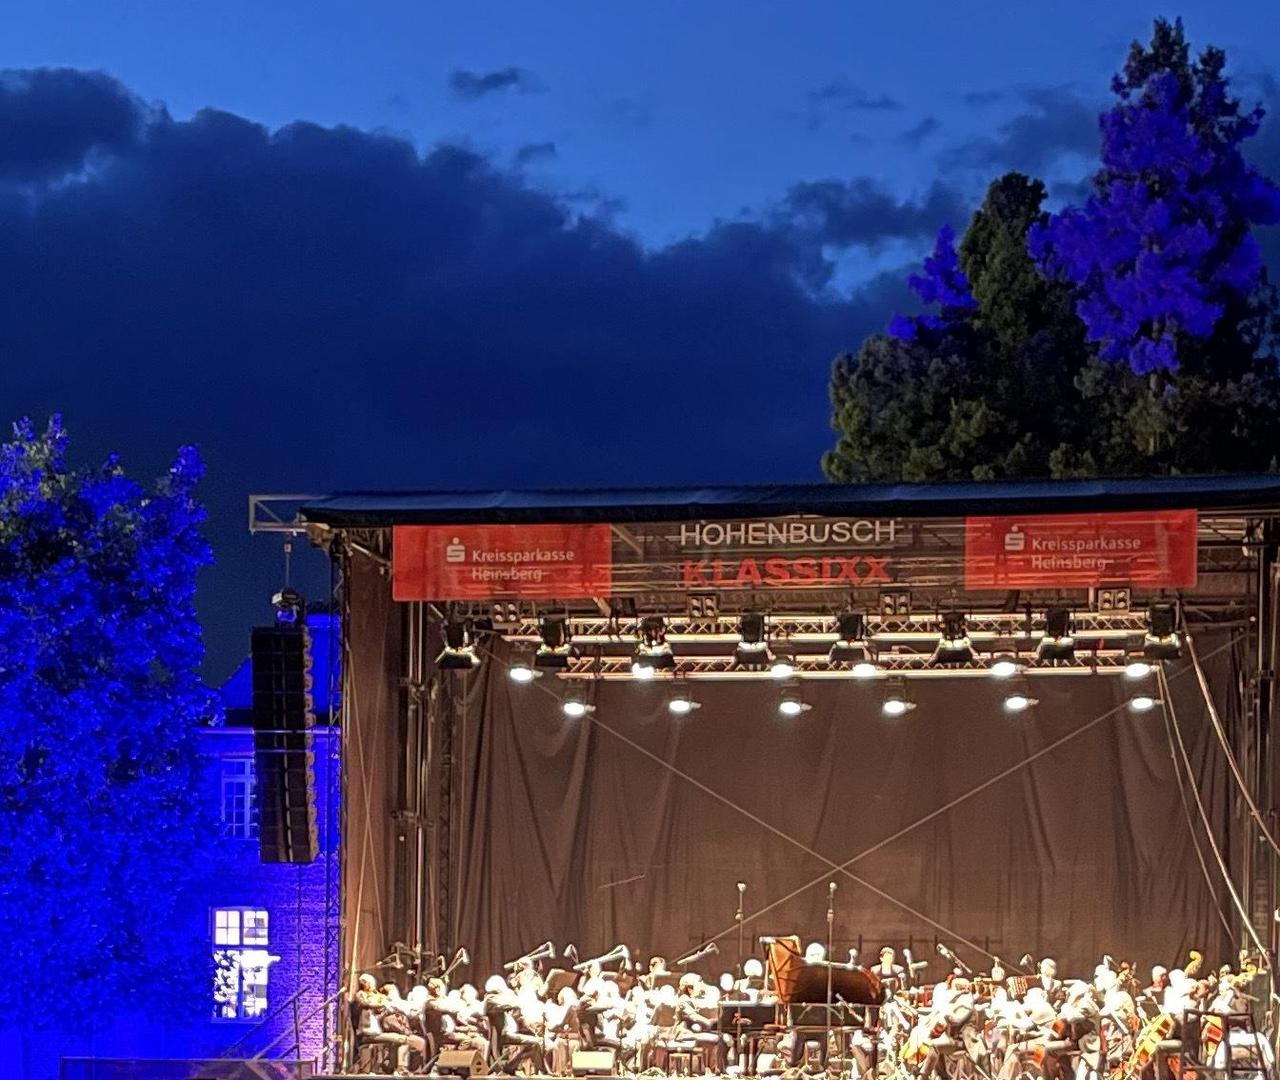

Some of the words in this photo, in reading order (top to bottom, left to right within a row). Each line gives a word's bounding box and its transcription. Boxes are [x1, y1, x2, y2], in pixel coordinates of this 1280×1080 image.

[680, 519, 896, 546] HOHENBUSCH
[1032, 535, 1142, 553] Kreissparkasse
[472, 547, 575, 565] Kreissparkasse
[1032, 554, 1107, 571] Heinsberg
[472, 567, 543, 582] Heinsberg
[681, 556, 893, 587] KLASSIXX
